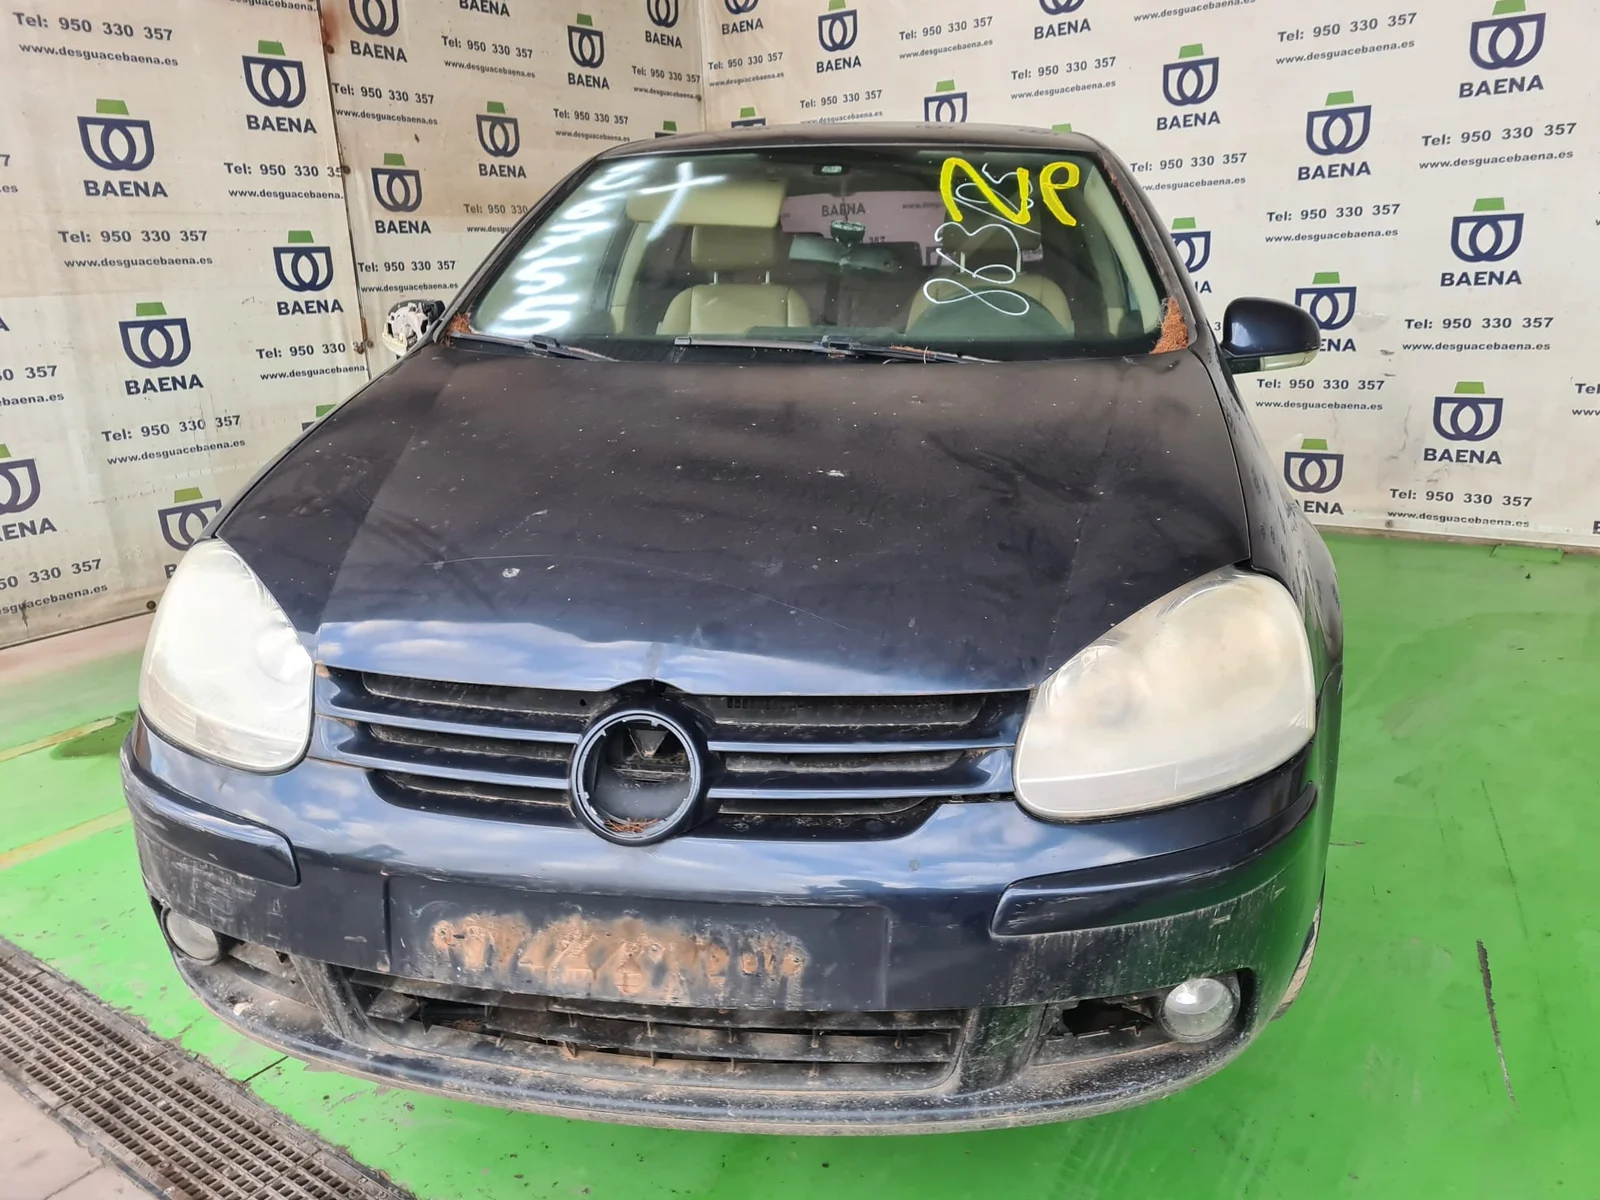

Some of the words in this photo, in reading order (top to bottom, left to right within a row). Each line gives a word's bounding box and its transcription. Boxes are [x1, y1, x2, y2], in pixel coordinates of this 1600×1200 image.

[229, 0, 317, 12] guacebaena.
[458, 0, 511, 18] BAENA
[12, 12, 49, 29] Tel:
[58, 17, 93, 33] 950
[102, 22, 135, 38] 330
[143, 27, 173, 42] 357
[721, 18, 764, 36] BAENA
[898, 30, 918, 41] Tel:
[922, 25, 943, 38] 950
[947, 21, 968, 34] 330
[973, 16, 994, 29] 357
[1033, 18, 1092, 41] BAENA
[1277, 29, 1305, 43] Tel:
[1312, 24, 1341, 38] 950
[1349, 18, 1379, 33] 330
[1387, 12, 1418, 28] 357
[440, 35, 462, 49] Tel:
[466, 40, 487, 53] 950
[491, 44, 511, 56] 330
[515, 47, 534, 59] 357
[644, 30, 683, 49] BAENA
[18, 45, 179, 67] www.desguacebaena.es
[349, 40, 408, 63] BAENA
[898, 40, 994, 60] www.desguacebaena.es
[1276, 40, 1415, 65] www.desguacebaena.es
[443, 61, 536, 79] www.desguacebaena.es
[707, 61, 724, 71] Tel:
[727, 58, 744, 69] 950
[747, 55, 764, 66] 330
[767, 52, 784, 63] 357
[816, 56, 862, 74] BAENA
[1010, 69, 1032, 81] Tel:
[1037, 65, 1060, 77] 950
[1065, 61, 1088, 74] 330
[1094, 56, 1117, 70] 357
[567, 72, 610, 90] BAENA
[631, 65, 647, 77] Tel:
[649, 68, 666, 80] 950
[667, 71, 683, 82] 330
[685, 74, 701, 84] 357
[332, 83, 355, 96] Tel:
[360, 86, 383, 100] 950
[388, 90, 410, 103] 330
[414, 93, 435, 105] 357
[1010, 81, 1117, 100] www.desguacebaena.es
[1458, 75, 1544, 99] BAENA
[799, 99, 817, 109] Tel:
[820, 96, 838, 107] 950
[842, 93, 861, 104] 330
[864, 89, 883, 101] 357
[245, 115, 318, 134] BAENA
[336, 108, 438, 126] www.desguacebaena.es
[552, 108, 571, 120] Tel:
[573, 111, 591, 122] 950
[593, 113, 610, 124] 330
[613, 115, 629, 125] 357
[800, 111, 883, 124] desguacebaena.es
[1156, 111, 1221, 131] BAENA
[1421, 134, 1452, 147] Tel:
[1460, 130, 1492, 144] 950
[1501, 126, 1534, 141] 330
[1543, 123, 1578, 137] 357
[1129, 162, 1153, 173] Tel:
[1159, 158, 1184, 171] 950
[1190, 156, 1215, 168] 330
[1222, 152, 1248, 165] 357
[1418, 151, 1574, 170] www.desguacebaena.es
[223, 162, 252, 175] Tel:
[259, 164, 287, 177] 950
[293, 165, 320, 178] 330
[478, 163, 527, 179] BAENA
[1297, 161, 1372, 181] BAENA
[83, 180, 169, 198] BAENA
[1142, 177, 1246, 191] w.desguacebaena.es
[228, 188, 344, 200] www.desguacebaena.
[462, 203, 483, 215] Tel:
[487, 204, 507, 215] 950
[511, 205, 528, 214] 330
[820, 202, 868, 218] BAENA
[1266, 211, 1292, 223] Tel:
[1300, 208, 1328, 221] 950
[1335, 206, 1364, 219] 330
[1371, 204, 1401, 217] 357
[374, 220, 432, 234] BAENA
[57, 231, 92, 244] Tel:
[99, 231, 132, 243] 950
[140, 230, 171, 243] 330
[179, 230, 208, 243] 357
[1264, 230, 1399, 243] www.desguacebaena.es
[63, 257, 213, 269] www.desguacebaena.es
[357, 262, 379, 273] Tel:
[383, 262, 406, 273] 950
[410, 261, 432, 272] 330
[436, 260, 456, 271] 357
[1440, 270, 1523, 287] BAENA
[361, 282, 459, 294] www.desguacebaena.es
[276, 299, 344, 316] BAENA
[1404, 319, 1433, 330] Tel:
[1442, 318, 1472, 330] 950
[1481, 318, 1513, 329] 330
[1521, 317, 1554, 329] 357
[255, 348, 283, 360] Tel:
[288, 345, 315, 357] 950
[321, 343, 347, 355] 330
[1401, 342, 1551, 353] www.desguacebaena.es
[24, 365, 58, 380] 357
[260, 364, 368, 380] www.desguacebaena.
[124, 374, 205, 396] BAENA
[1256, 379, 1282, 389] Tel:
[1288, 379, 1315, 390] 950
[1322, 380, 1350, 390] 330
[1357, 380, 1386, 391] 357
[1574, 383, 1600, 395] Tel
[1255, 401, 1384, 411] www.desguacebaena.es
[100, 429, 133, 443] Tel:
[140, 424, 170, 438] 950
[178, 419, 207, 433] 330
[214, 415, 241, 429] 357
[106, 440, 246, 466] www.desguacebaena.es
[1423, 448, 1502, 465] BAENA
[1389, 489, 1417, 500] Tel:
[1425, 491, 1455, 503] 950
[1463, 493, 1493, 505] 330
[1501, 496, 1533, 508] 357
[1303, 500, 1344, 516] ENA
[1386, 510, 1530, 528] www.desguacebaena.es
[0, 517, 57, 542] ENA
[0, 576, 19, 591] 50
[28, 567, 62, 584] 330
[71, 558, 102, 575] 357
[0, 584, 108, 615] sguacebaena.es
